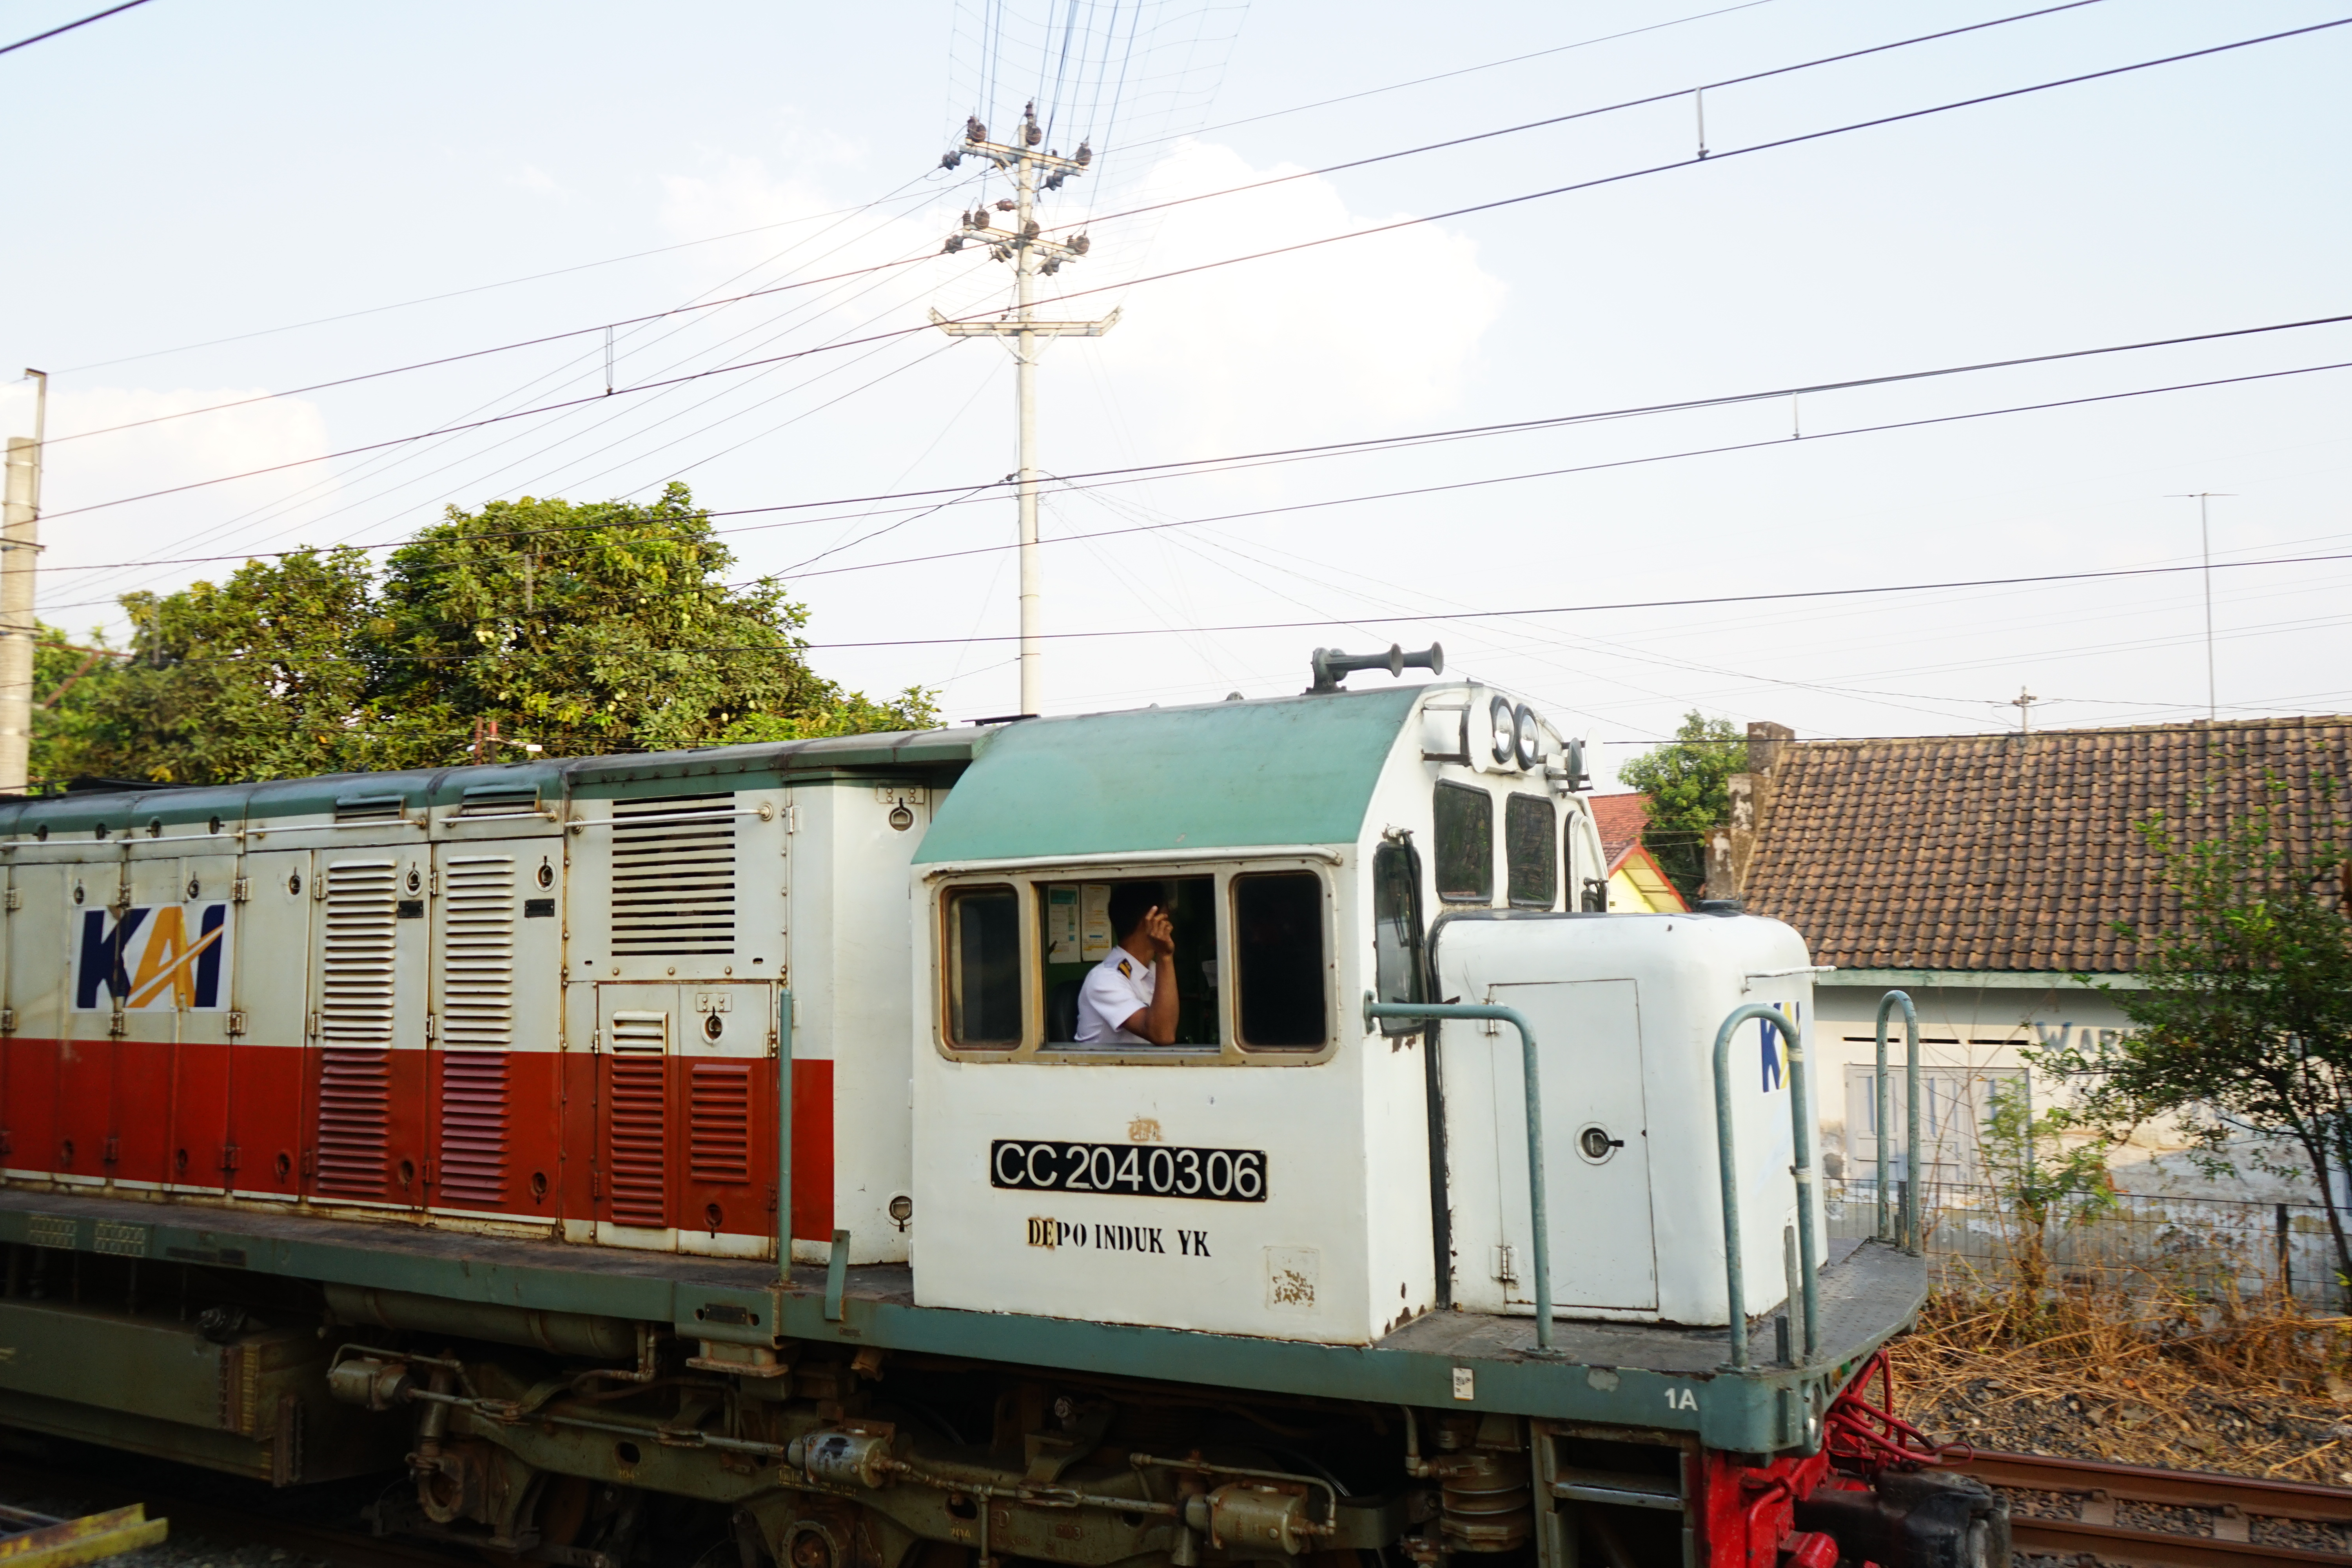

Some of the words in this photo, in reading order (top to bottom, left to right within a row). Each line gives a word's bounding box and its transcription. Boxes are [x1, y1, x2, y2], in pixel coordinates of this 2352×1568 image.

[76, 904, 226, 1008] KAI
[1028, 1219, 1087, 1247] DEPO
[1095, 1223, 1166, 1254] INDUK
[1178, 1230, 1212, 1257] YK
[1664, 1387, 1699, 1411] 1A
